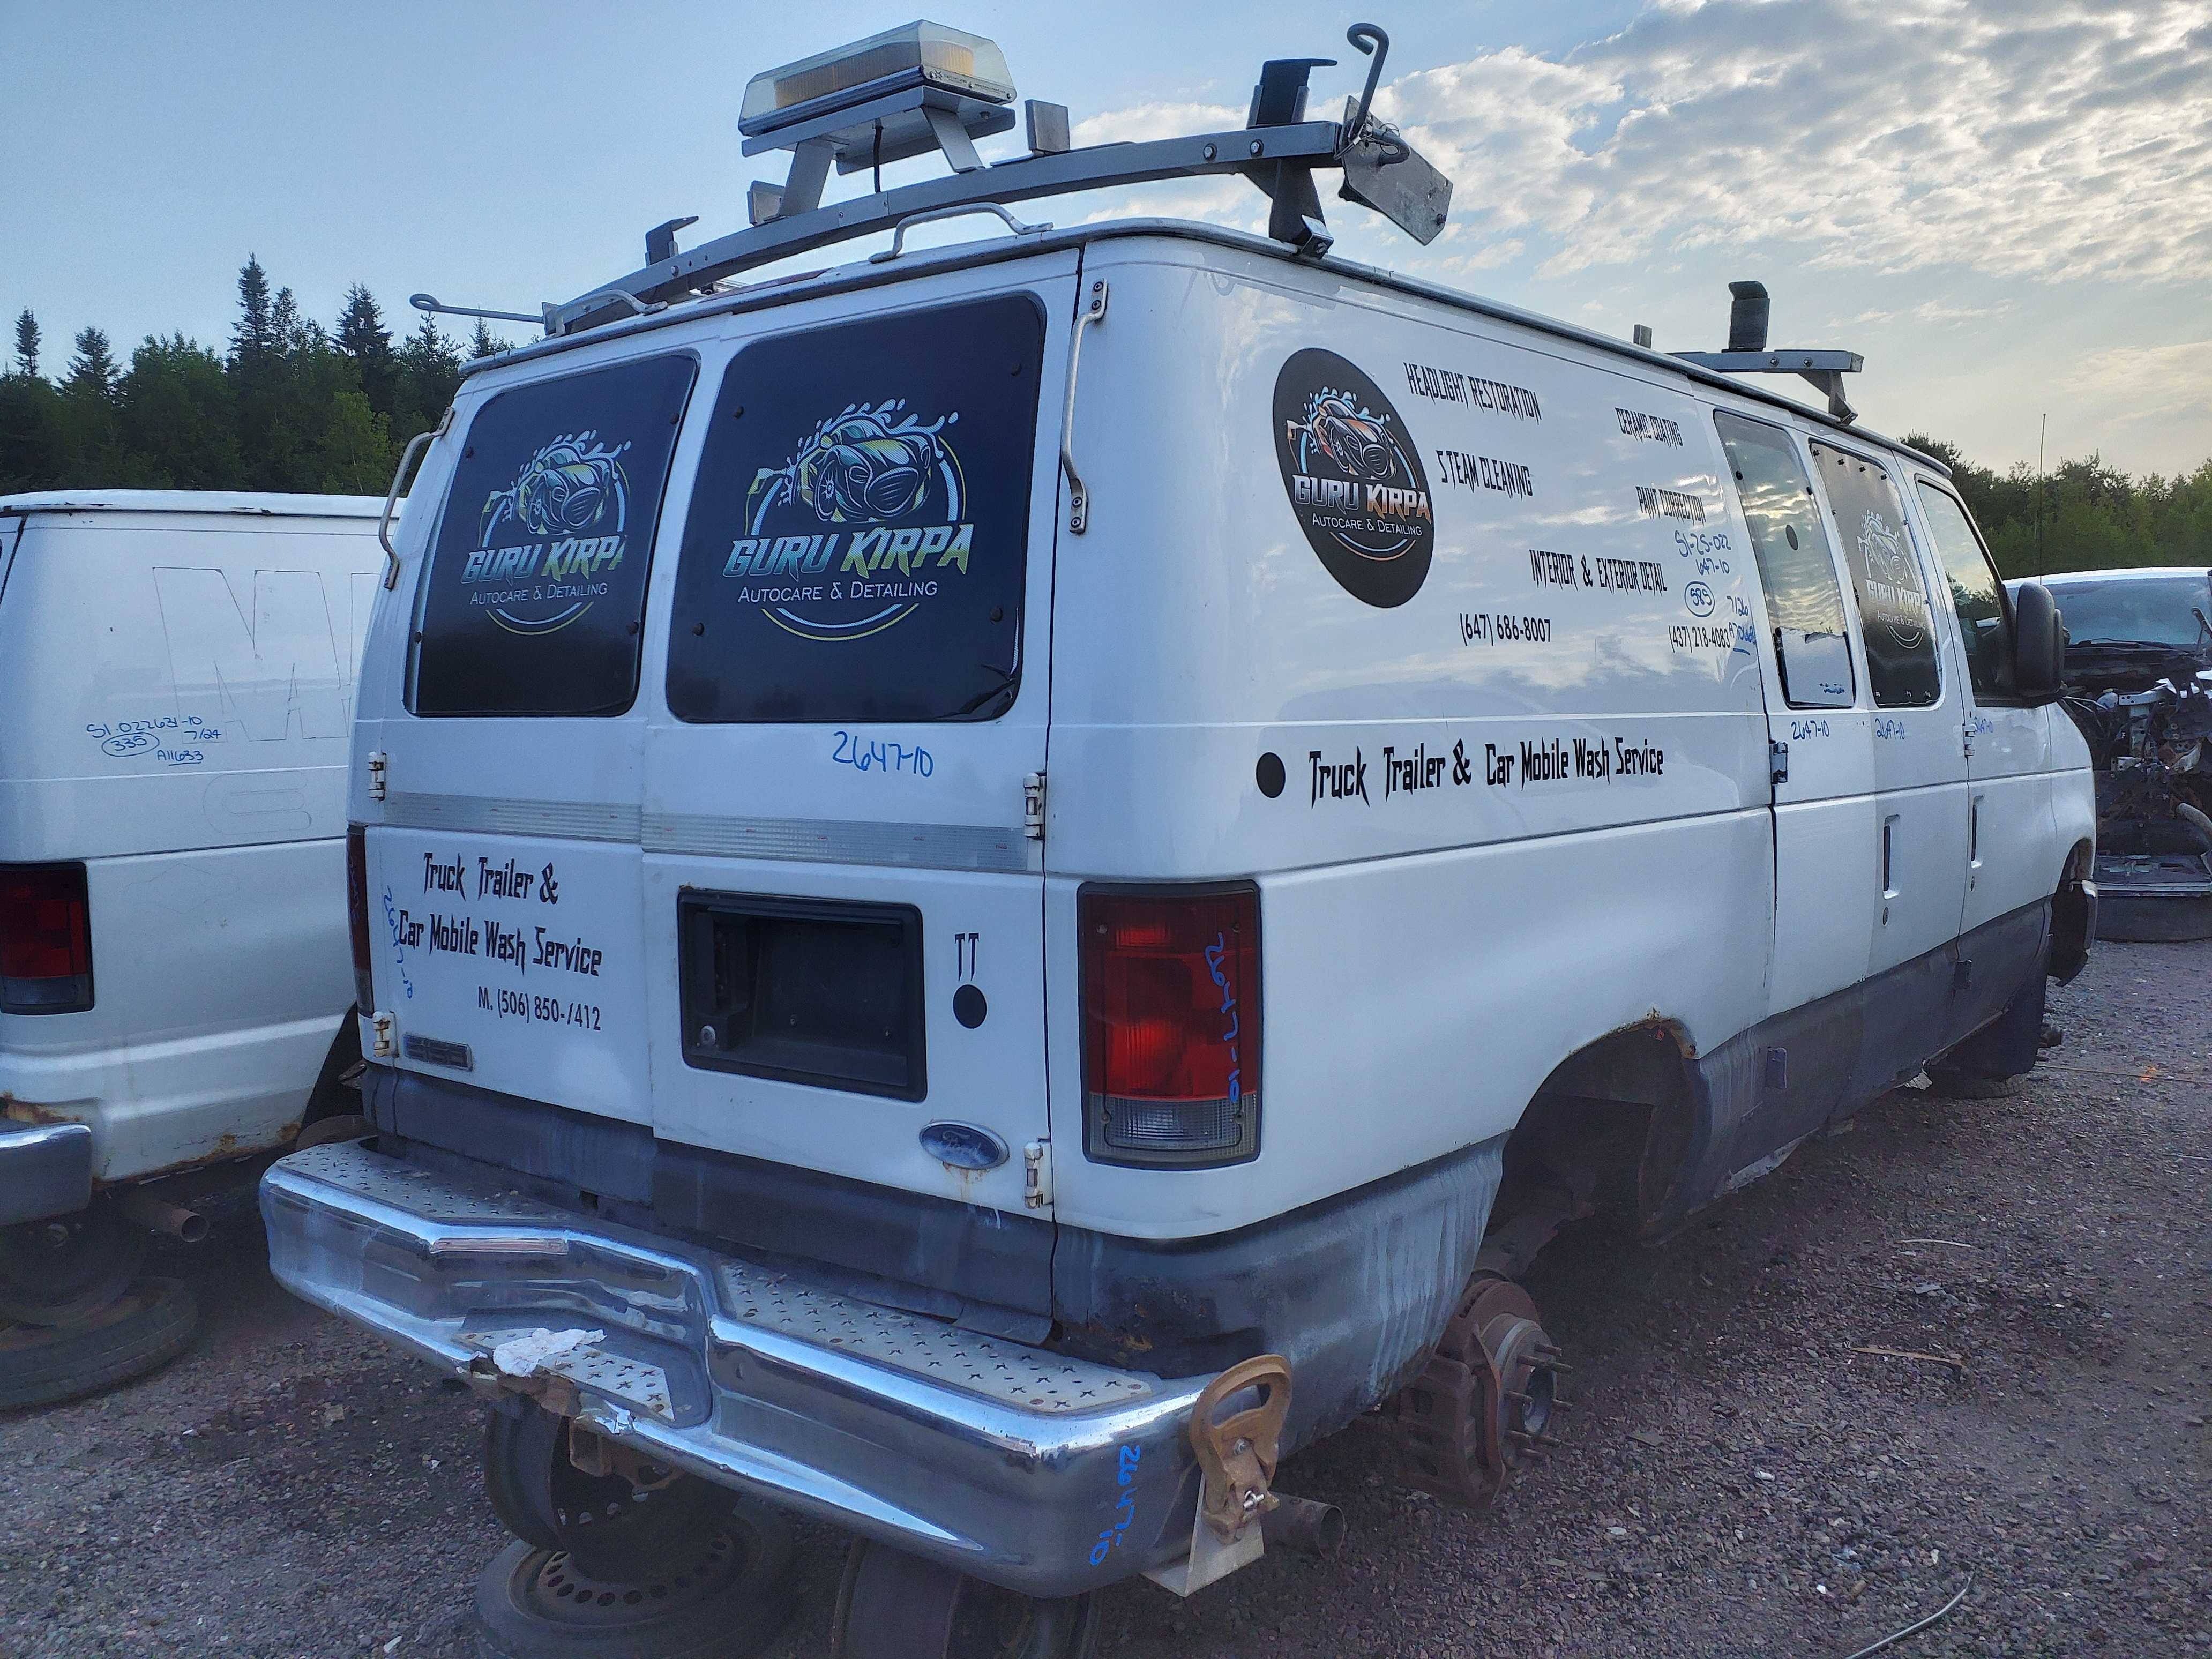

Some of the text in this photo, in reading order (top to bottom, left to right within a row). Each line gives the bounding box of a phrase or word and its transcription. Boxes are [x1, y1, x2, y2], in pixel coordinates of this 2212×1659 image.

[1403, 362, 1542, 425] HEADLIGHT RESTORATION
[1615, 407, 1683, 450] CERAMIC COATING
[1435, 450, 1533, 501] STEAM CLEANING
[1292, 475, 1432, 525] GURU KIRPA
[1635, 486, 1706, 527] PAINT CORRECTION
[1312, 512, 1423, 537] AUTOCARE & DETAILING
[460, 535, 626, 586] GURU KIRPA
[721, 524, 975, 583] GURU KIRPA
[1529, 549, 1668, 596] INTERIOR & EXTERIOR DETAIL
[469, 582, 608, 606] AUTOCARE & DETAILING
[738, 581, 938, 603] AUTOCARE & DETAILING
[1865, 579, 1896, 609] GURU
[1460, 612, 1551, 646] (647) 686-8007
[1668, 625, 1730, 653] (437) 218-4083
[832, 730, 933, 777] 2647-10
[1309, 735, 1663, 809] Truck Trailer & Car Mobile Wash Service
[423, 852, 558, 905] Truck Trailer &
[398, 909, 603, 976] Car Mobile Wash Service
[478, 985, 494, 1011] M.
[497, 988, 530, 1023] (506)
